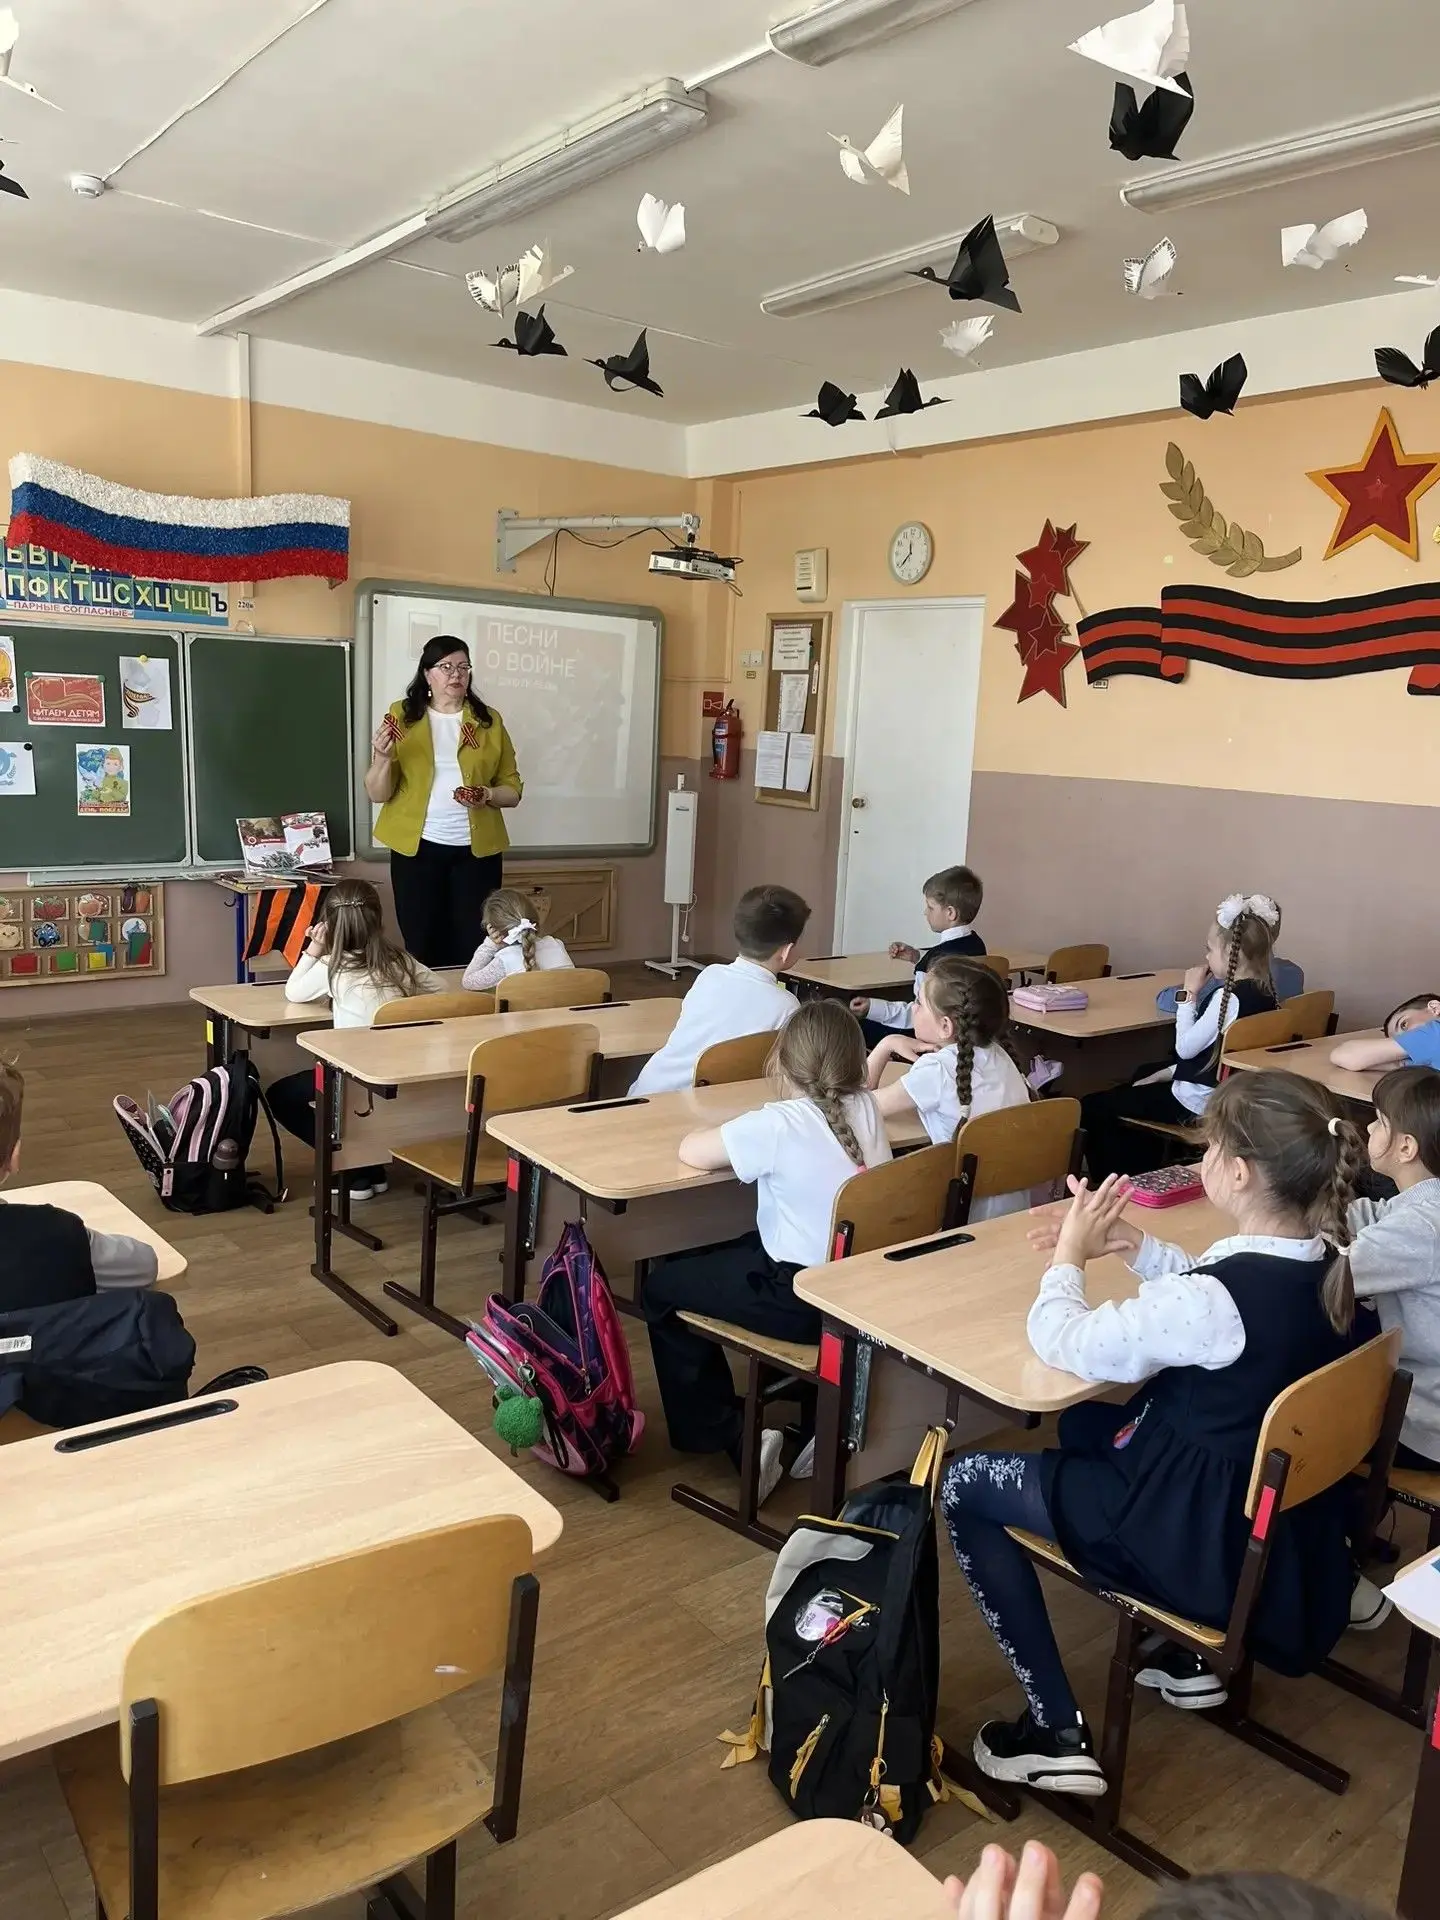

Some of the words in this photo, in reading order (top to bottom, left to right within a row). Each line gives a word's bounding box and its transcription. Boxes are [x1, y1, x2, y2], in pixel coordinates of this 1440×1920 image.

[13, 601, 60, 612] ПАРНЫЕ
[63, 604, 129, 617] СОГЛАСНЫЕ
[487, 621, 559, 649] ПЕСНИ
[486, 649, 500, 669] О
[506, 650, 577, 681] ВОЙНЕ
[32, 708, 67, 717] ЧИТАЕМ
[68, 709, 100, 718] ДЕТЯМ
